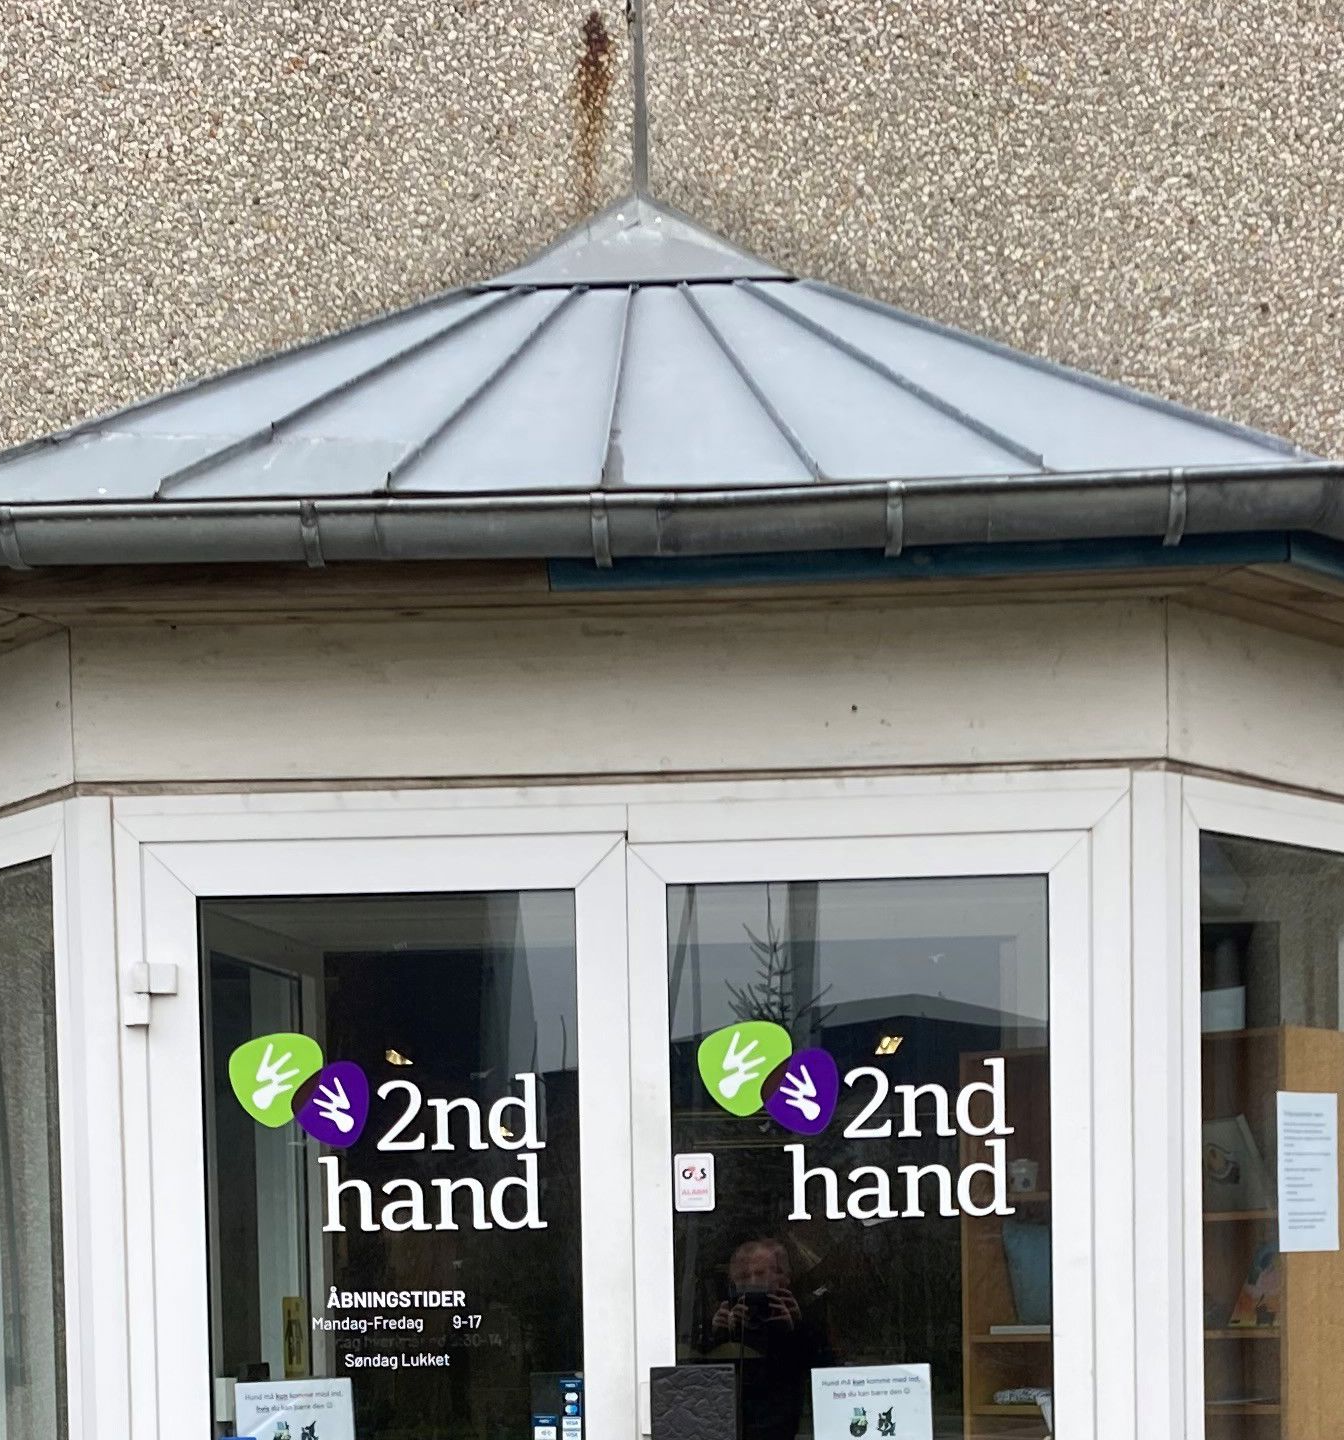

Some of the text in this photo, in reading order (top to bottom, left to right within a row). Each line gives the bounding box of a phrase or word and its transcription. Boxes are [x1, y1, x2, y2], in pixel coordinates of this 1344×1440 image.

[376, 1072, 547, 1152] 2nd
[843, 1057, 1015, 1139] 2nd
[317, 1152, 548, 1233] hand
[783, 1138, 1017, 1222] hand
[312, 1315, 482, 1333] Mandag-Fredag 9-17
[327, 1286, 466, 1309] ÅBNINGSTIDER
[344, 1353, 450, 1370] Søndag Lukket
